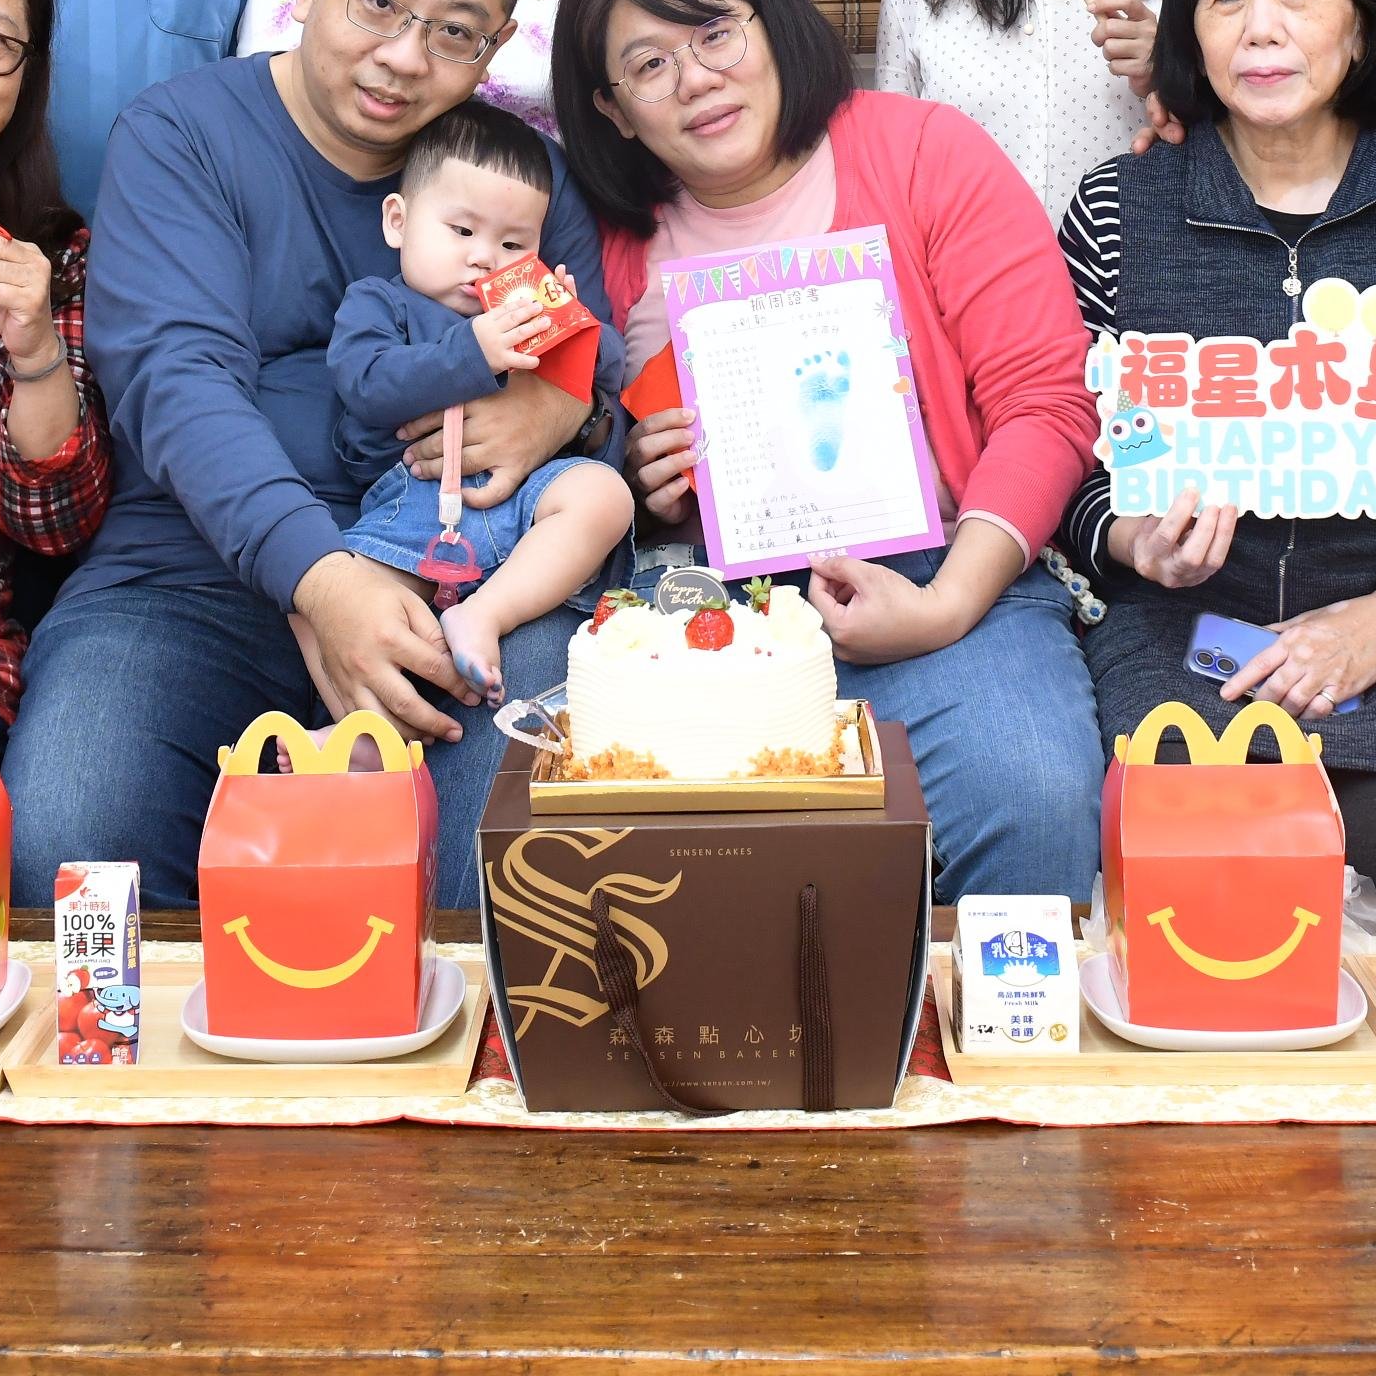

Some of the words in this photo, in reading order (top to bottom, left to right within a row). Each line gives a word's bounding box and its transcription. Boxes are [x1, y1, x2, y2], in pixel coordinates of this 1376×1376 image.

[750, 287, 819, 311] 抓周證書
[662, 580, 704, 597] Happy
[669, 848, 713, 857] SENSEN
[717, 847, 753, 856] CAKES
[68, 901, 111, 912] 果汁時刻
[62, 914, 116, 931] 100%
[63, 932, 116, 959] 蘋果
[1010, 1015, 1034, 1025] 美味
[719, 1048, 796, 1060] BAKER
